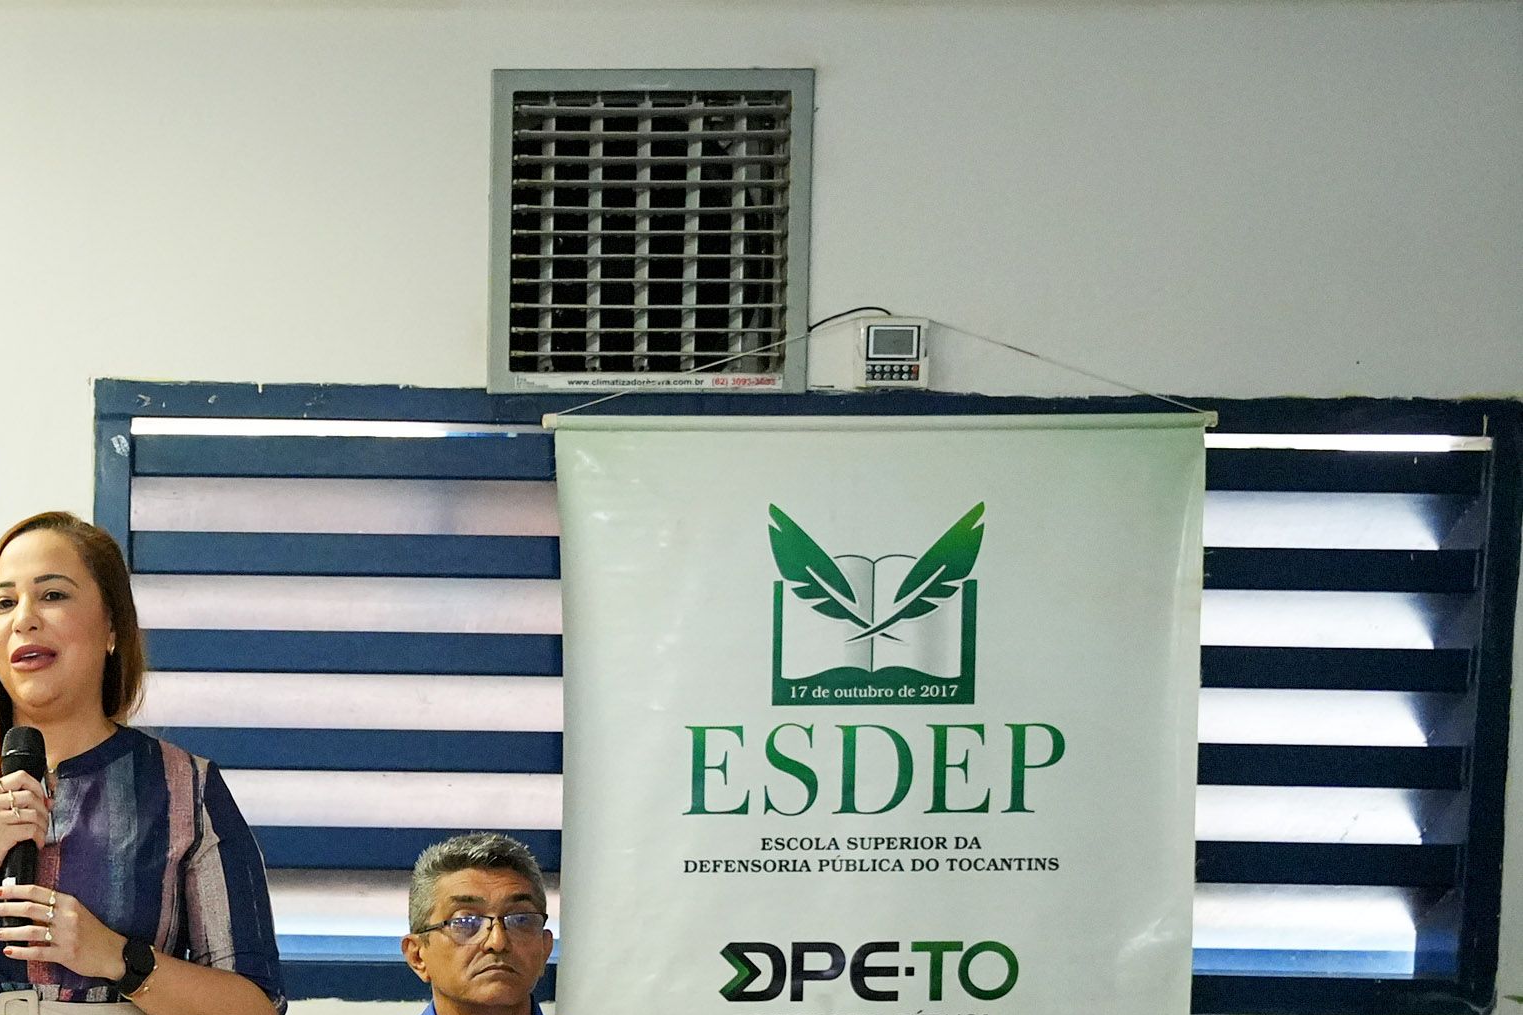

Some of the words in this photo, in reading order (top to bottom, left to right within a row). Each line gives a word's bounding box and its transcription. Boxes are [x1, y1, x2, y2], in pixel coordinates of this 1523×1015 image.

[791, 686, 807, 698] 17
[812, 686, 829, 698] de
[834, 685, 893, 698] outubro
[898, 685, 915, 697] de
[920, 685, 958, 697] 2017
[683, 723, 1065, 816] ESDEP
[761, 838, 840, 850] ESCOLA
[847, 837, 948, 850] SUPERIOR
[955, 837, 981, 849] DA
[684, 860, 811, 873] DEFENSORIA
[818, 855, 904, 872] PÚBLICA
[911, 858, 939, 871] DO
[946, 858, 1059, 871] TOCANTINS
